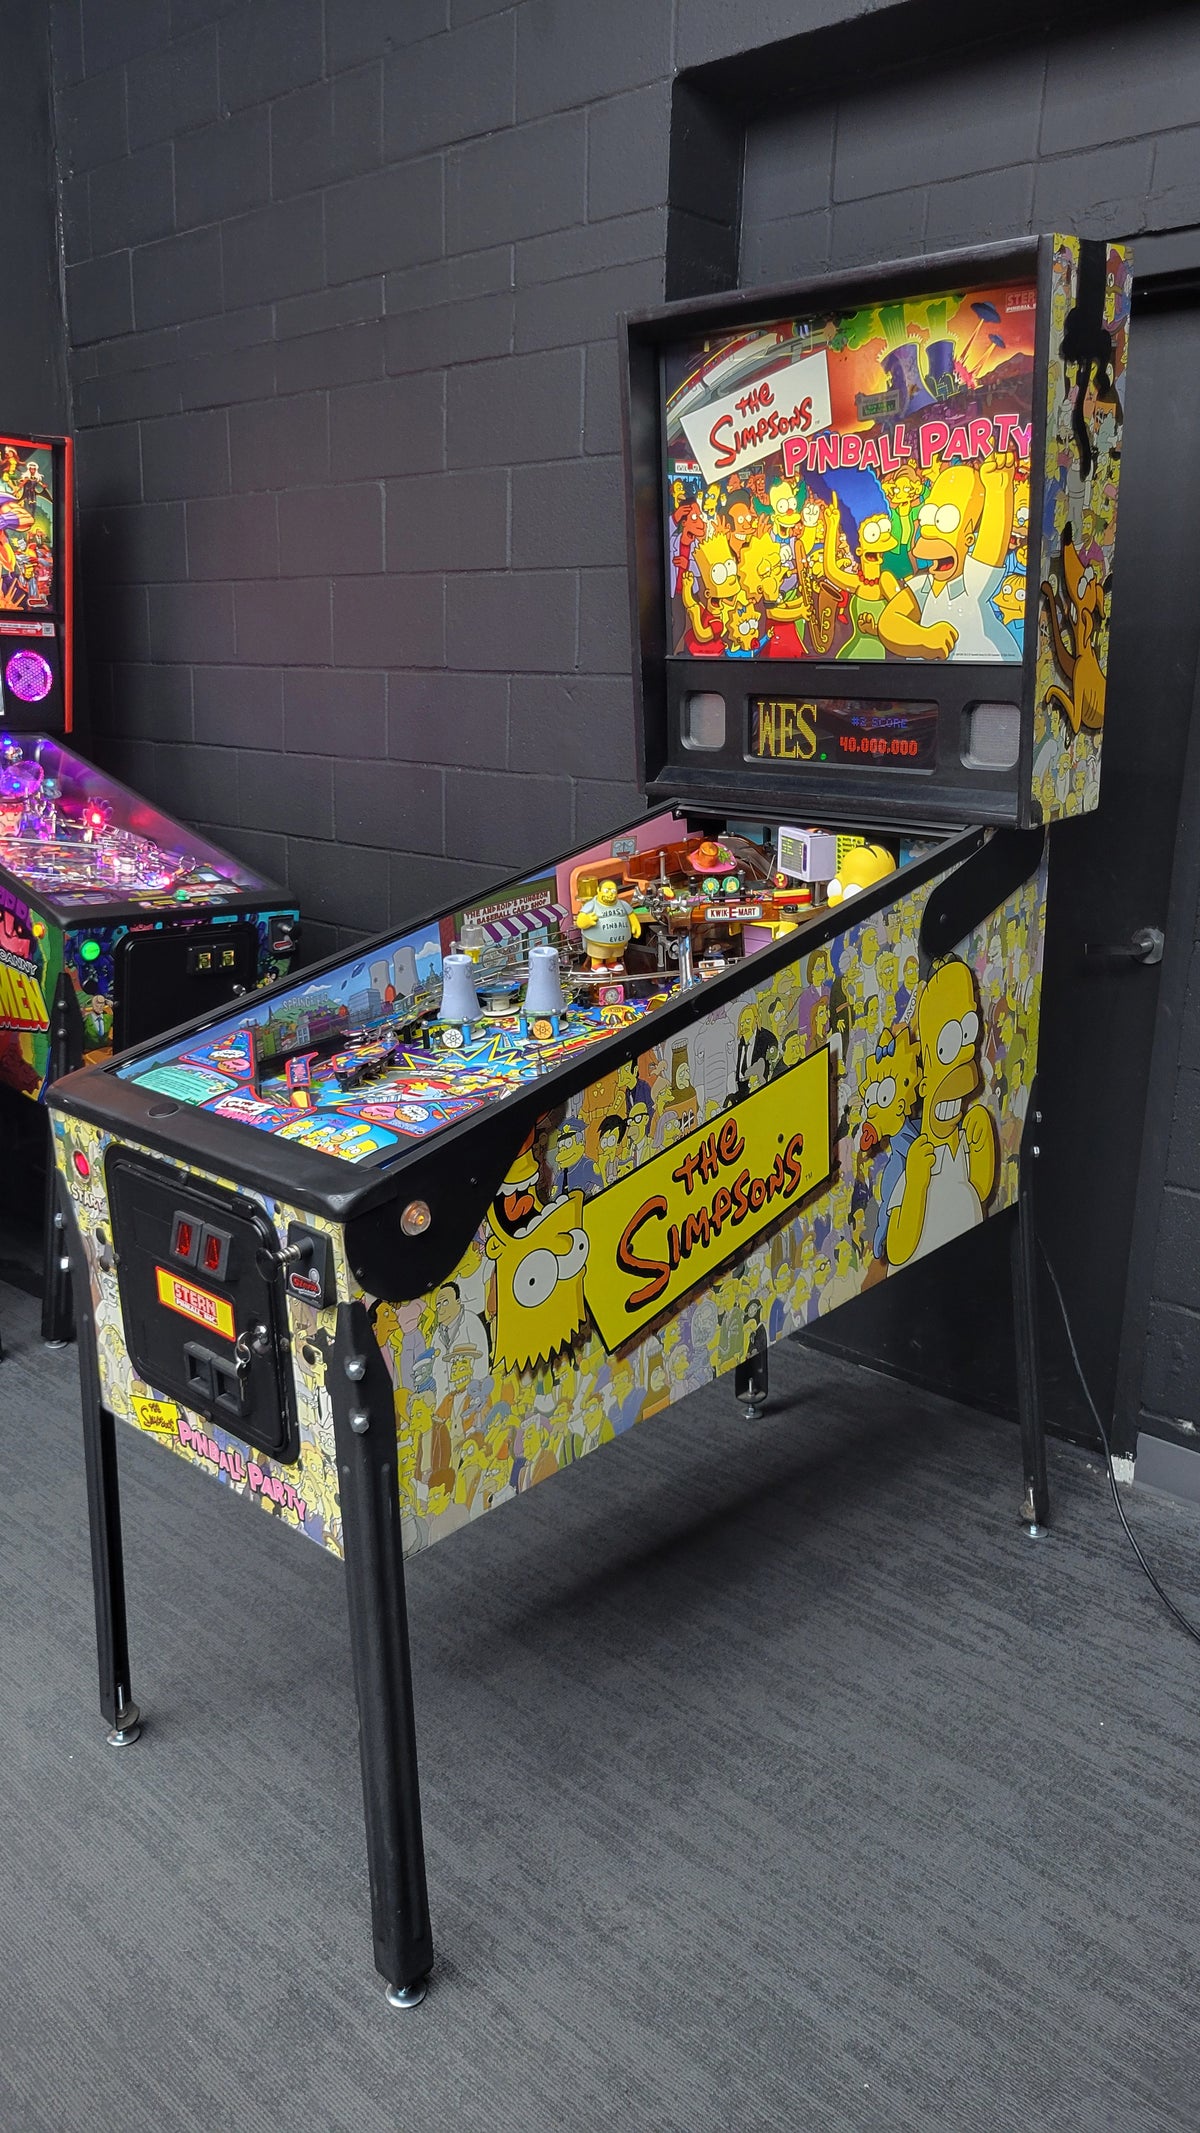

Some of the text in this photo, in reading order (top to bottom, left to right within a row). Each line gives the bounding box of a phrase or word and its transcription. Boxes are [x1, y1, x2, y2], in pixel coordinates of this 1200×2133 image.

[735, 382, 775, 418] THE
[709, 396, 813, 469] SIMPSONS
[782, 413, 1032, 478] PINBALL PARTY
[757, 702, 817, 759] WES
[851, 716, 908, 729] #2 SCORE
[465, 891, 549, 920] THE ANDROID'S DUNGEON
[477, 910, 511, 924] BASEBALL
[512, 904, 530, 914] CARD
[530, 898, 548, 909] SHOP
[602, 922, 629, 930] PINBALL
[672, 1118, 746, 1196] THE
[71, 1182, 103, 1212] START
[616, 1133, 804, 1313] SIMPSONS
[173, 1281, 217, 1318] STERN
[148, 1402, 161, 1414] THE
[176, 1418, 307, 1522] PINBALL PARTY
